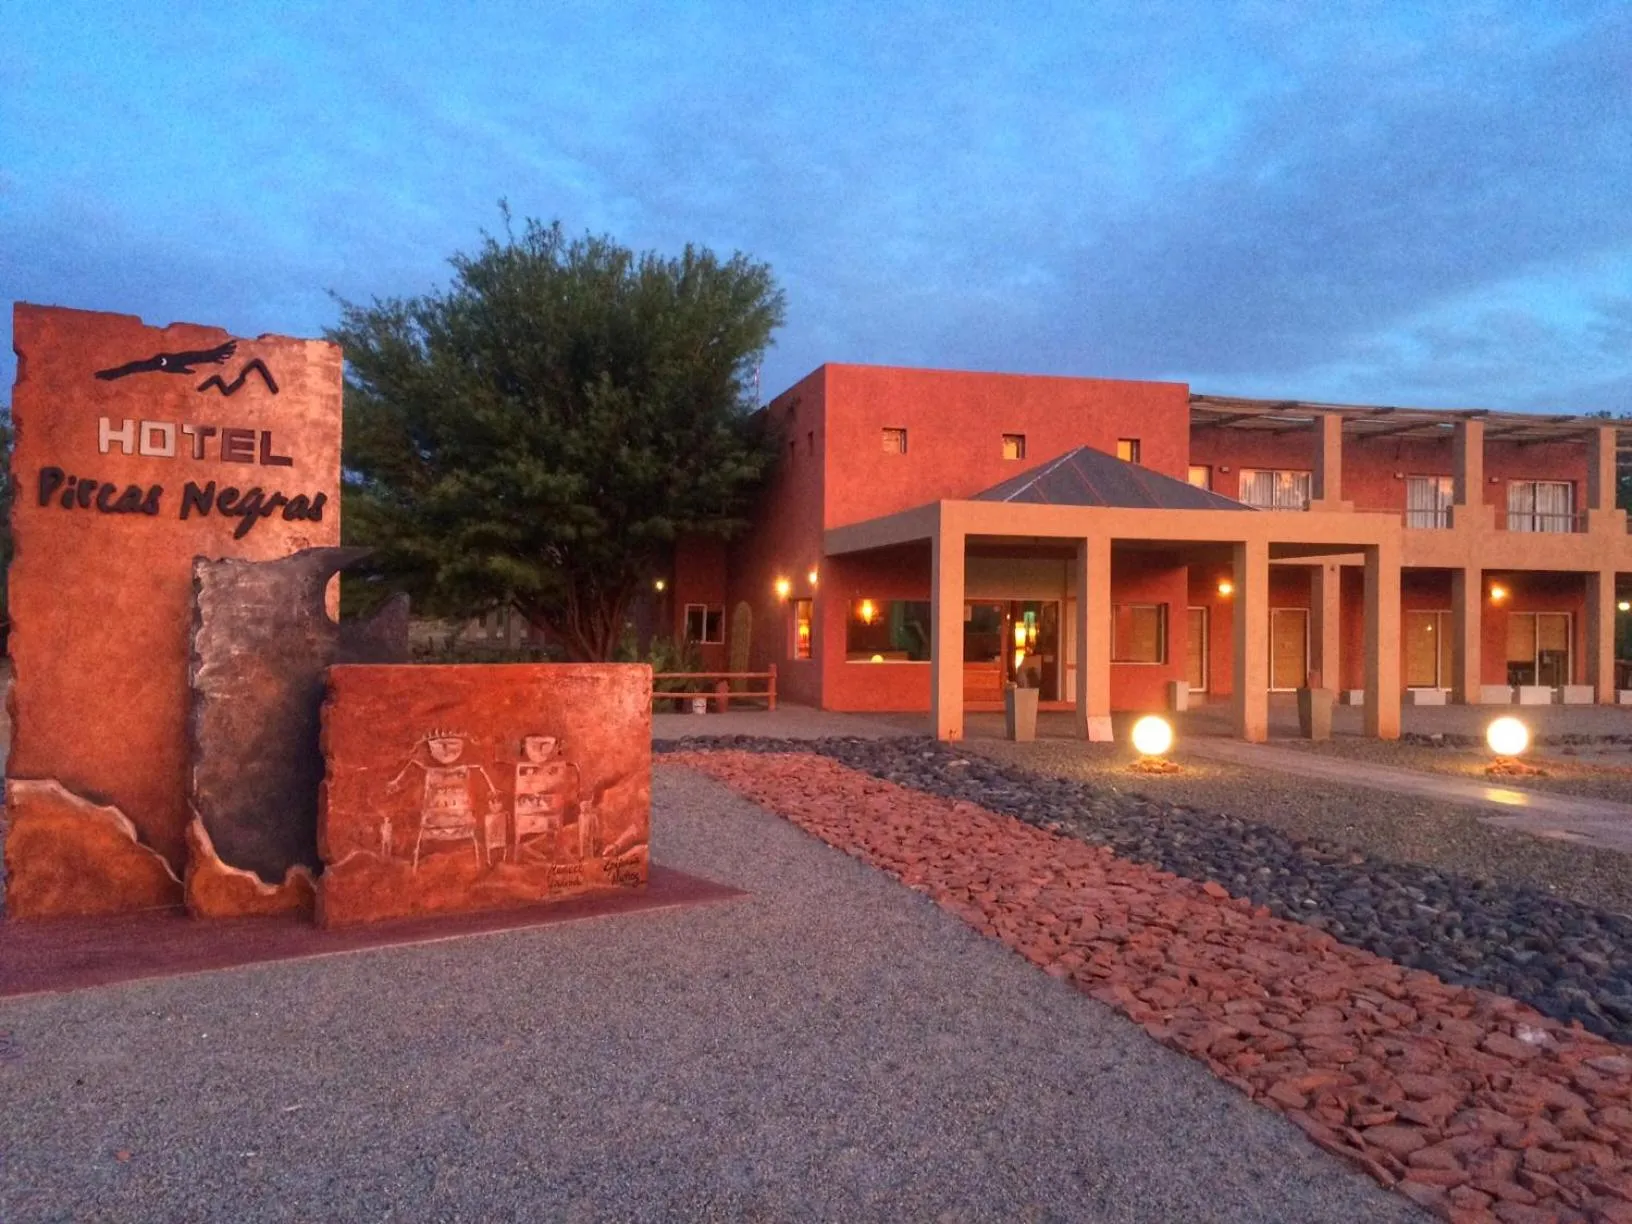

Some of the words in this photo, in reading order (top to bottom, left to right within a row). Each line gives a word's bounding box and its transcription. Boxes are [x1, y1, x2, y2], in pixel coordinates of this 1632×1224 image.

[98, 416, 293, 467] HOTEL
[39, 466, 164, 516] Pircas
[180, 480, 328, 539] Negras
